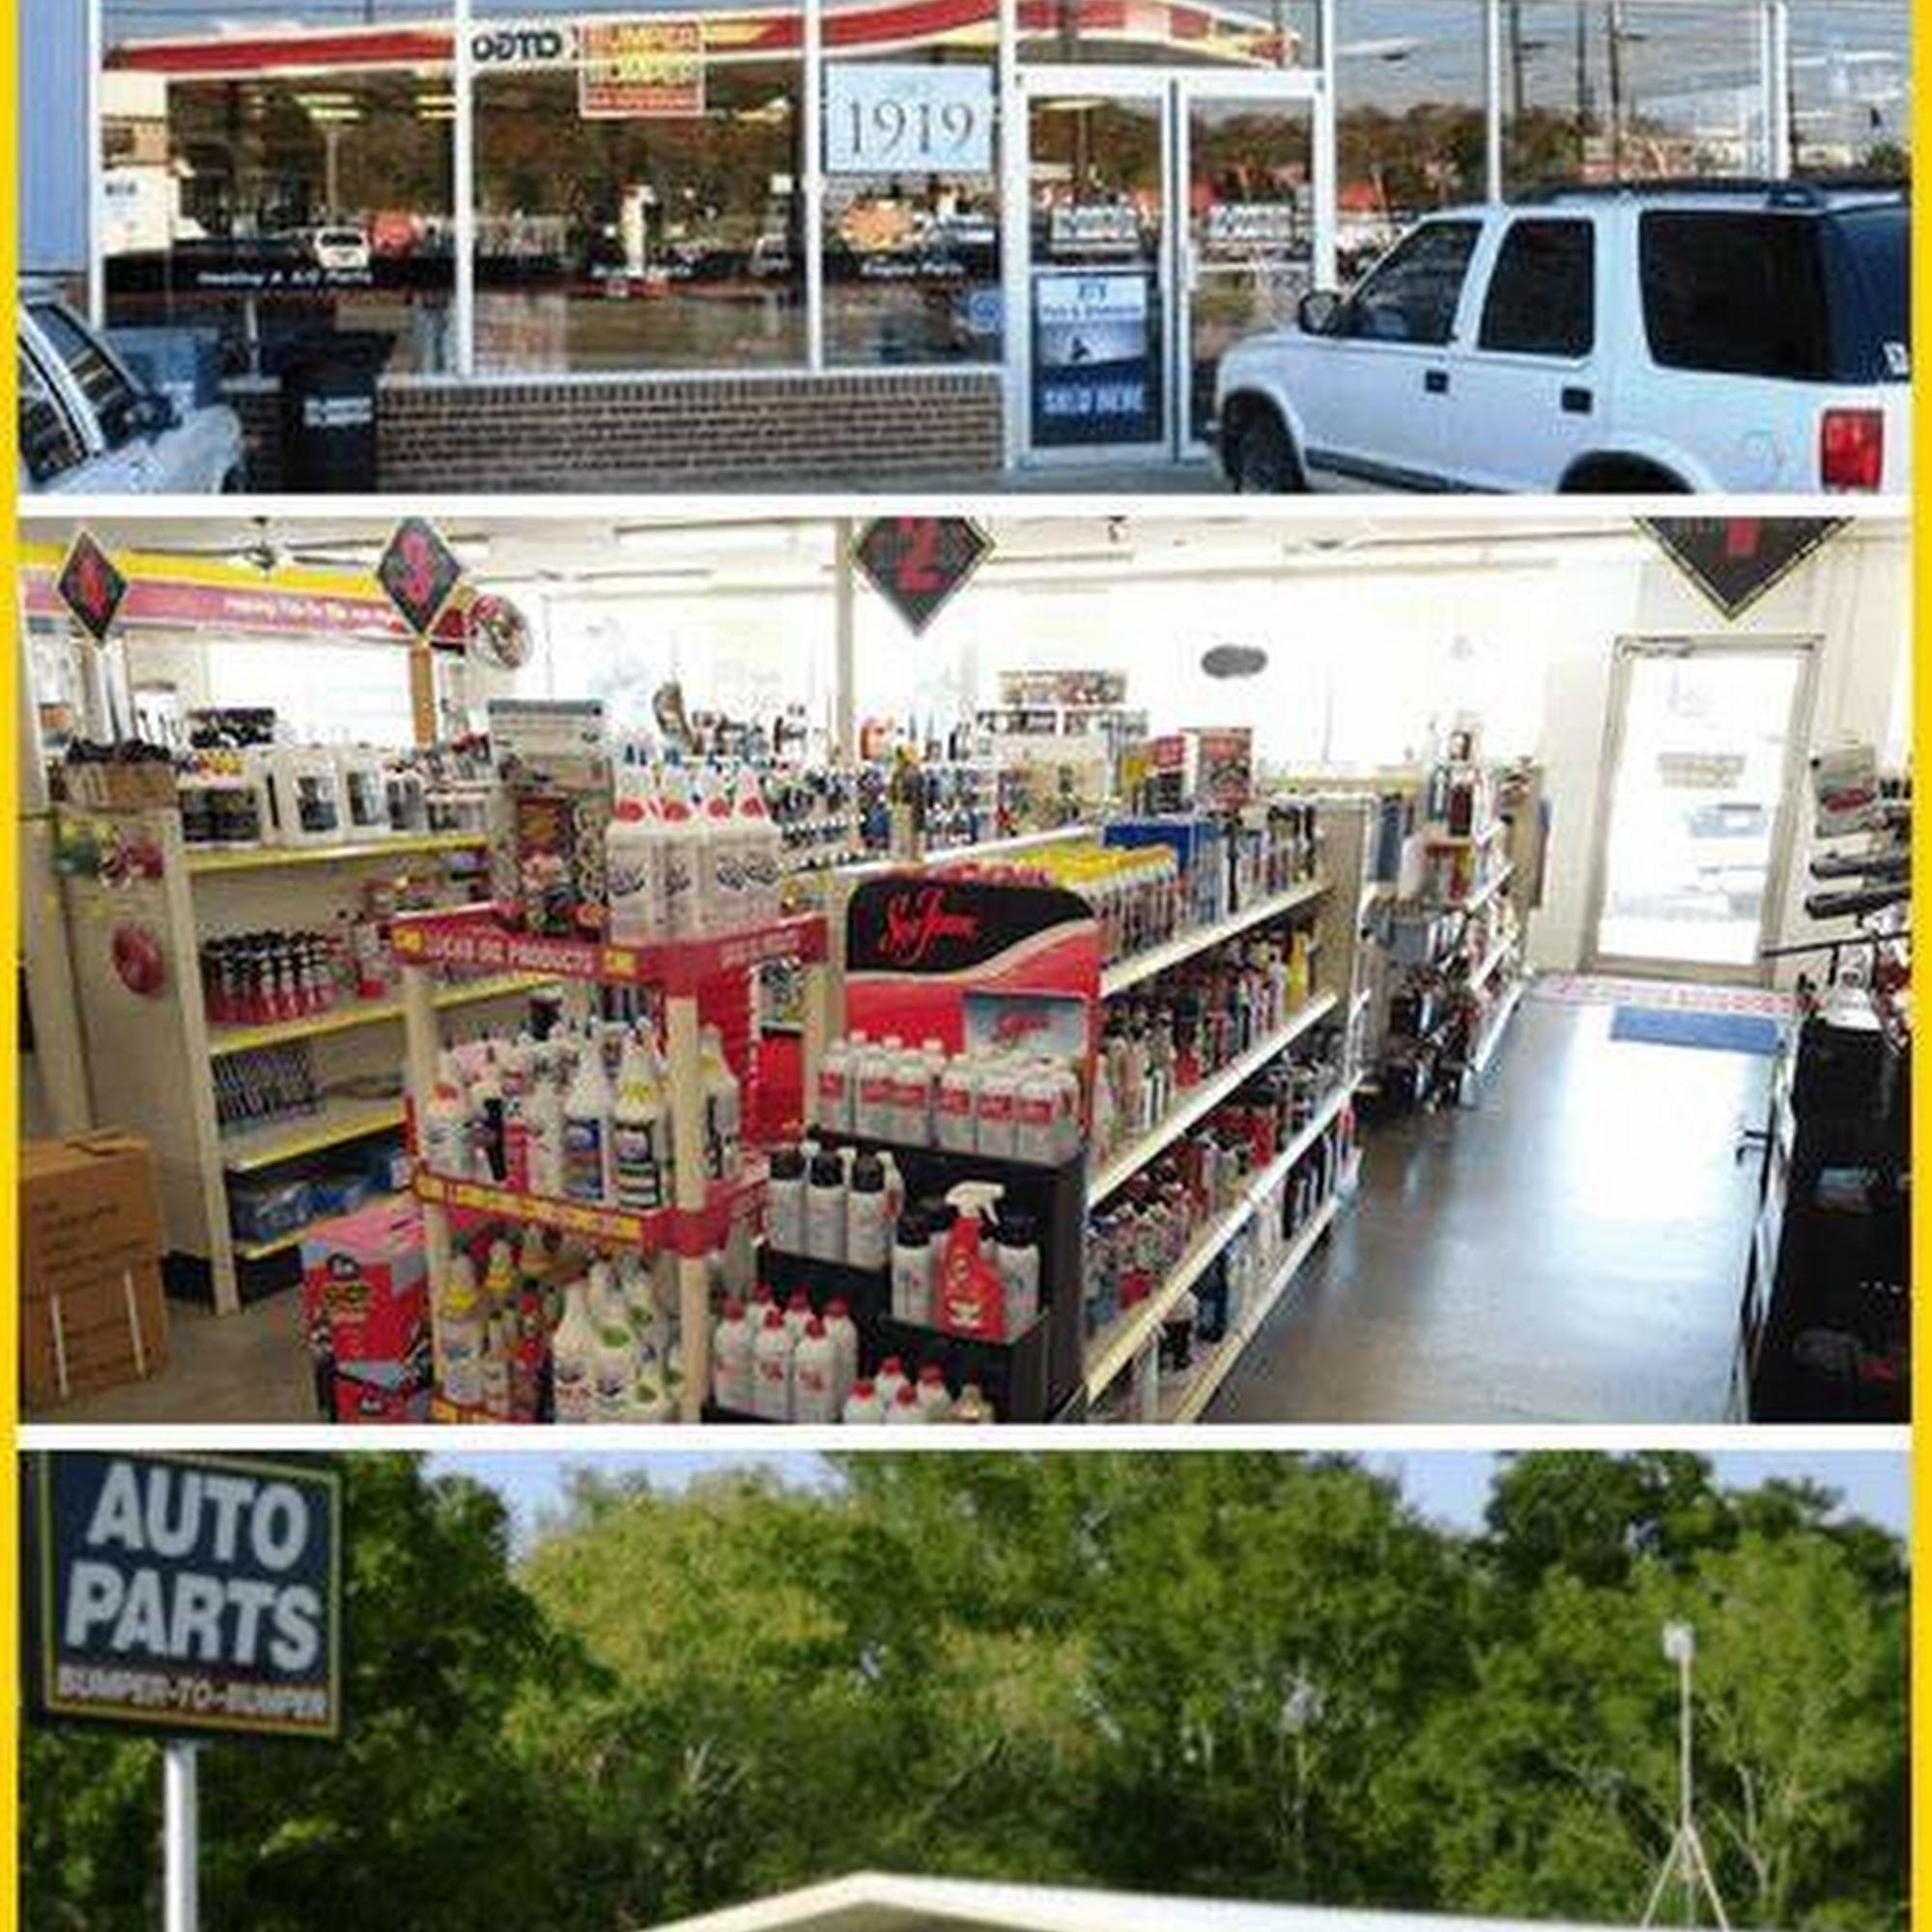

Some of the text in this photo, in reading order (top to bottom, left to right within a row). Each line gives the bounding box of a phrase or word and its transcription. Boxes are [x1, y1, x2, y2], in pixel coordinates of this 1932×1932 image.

[848, 99, 974, 153] 1919
[87, 1462, 308, 1572] AUTO
[64, 1561, 321, 1672] PARTS
